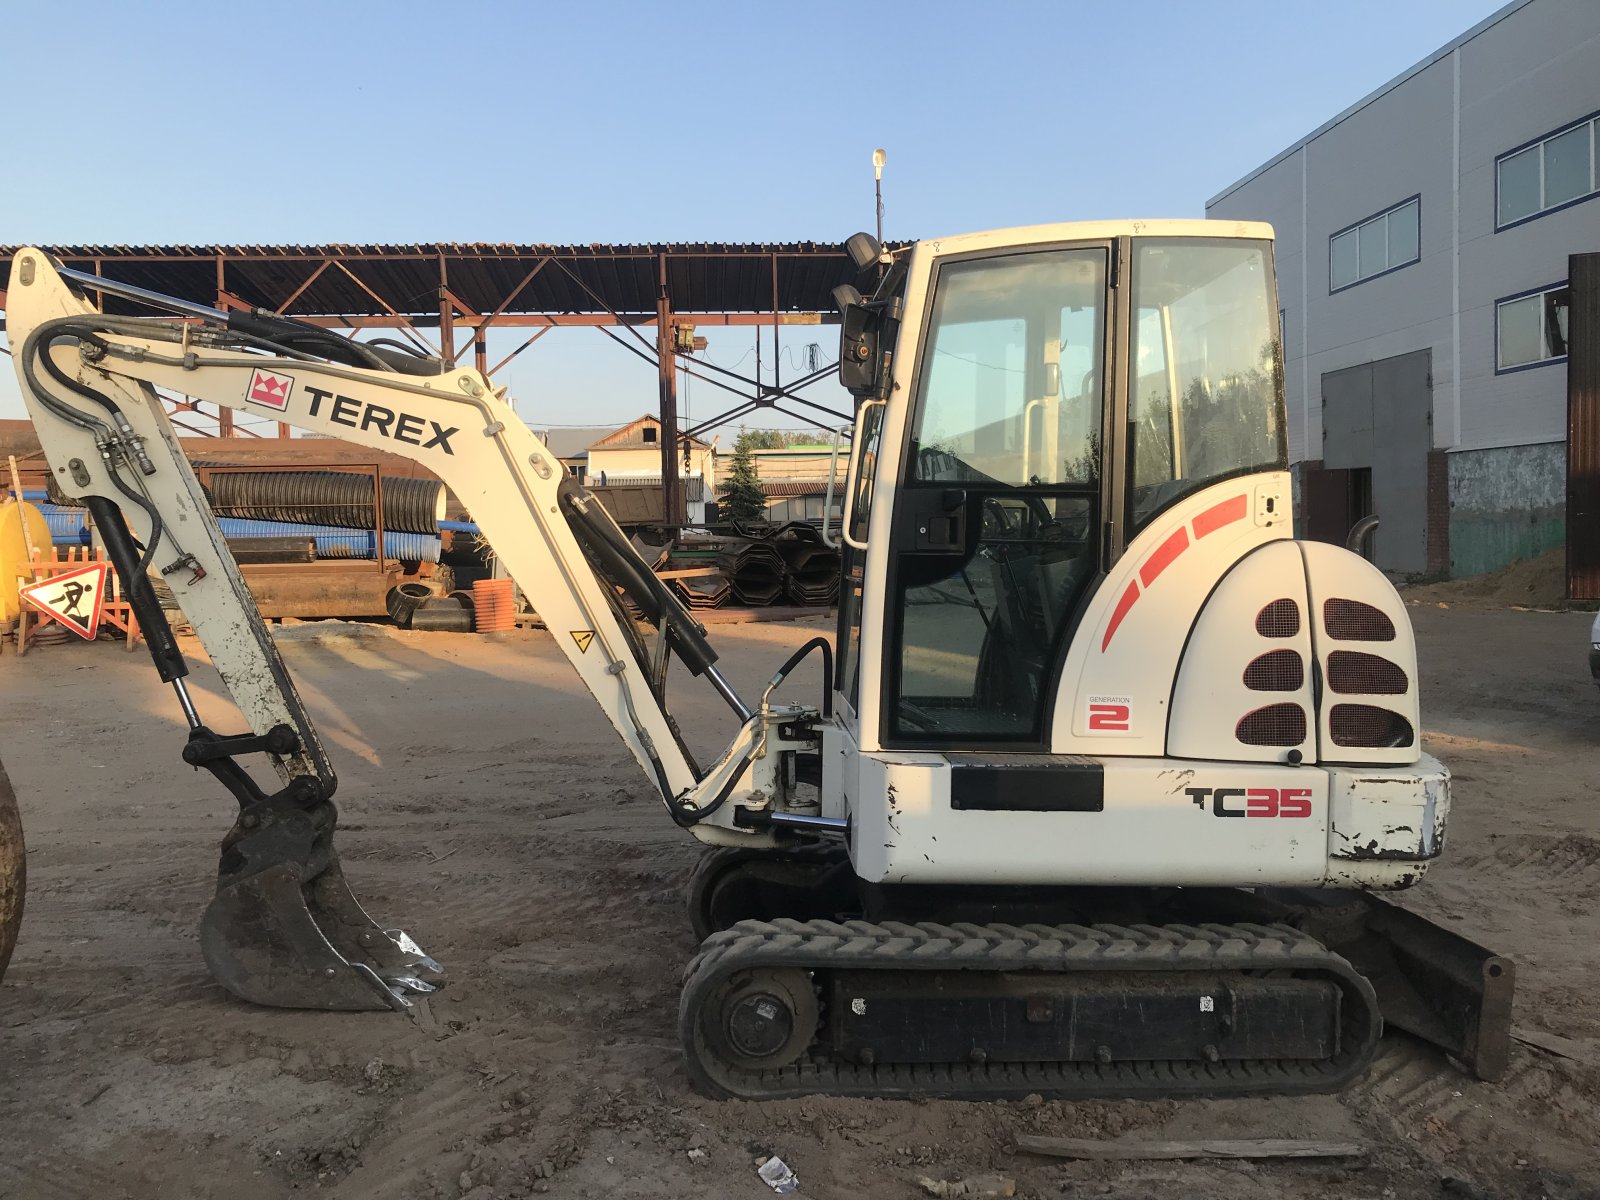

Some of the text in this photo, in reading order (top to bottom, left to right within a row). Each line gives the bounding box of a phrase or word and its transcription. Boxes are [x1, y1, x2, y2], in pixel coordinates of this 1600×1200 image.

[303, 385, 461, 456] TEREX
[1089, 696, 1130, 704] GENERATION
[1089, 704, 1130, 731] 2
[1184, 787, 1313, 818] TC35
